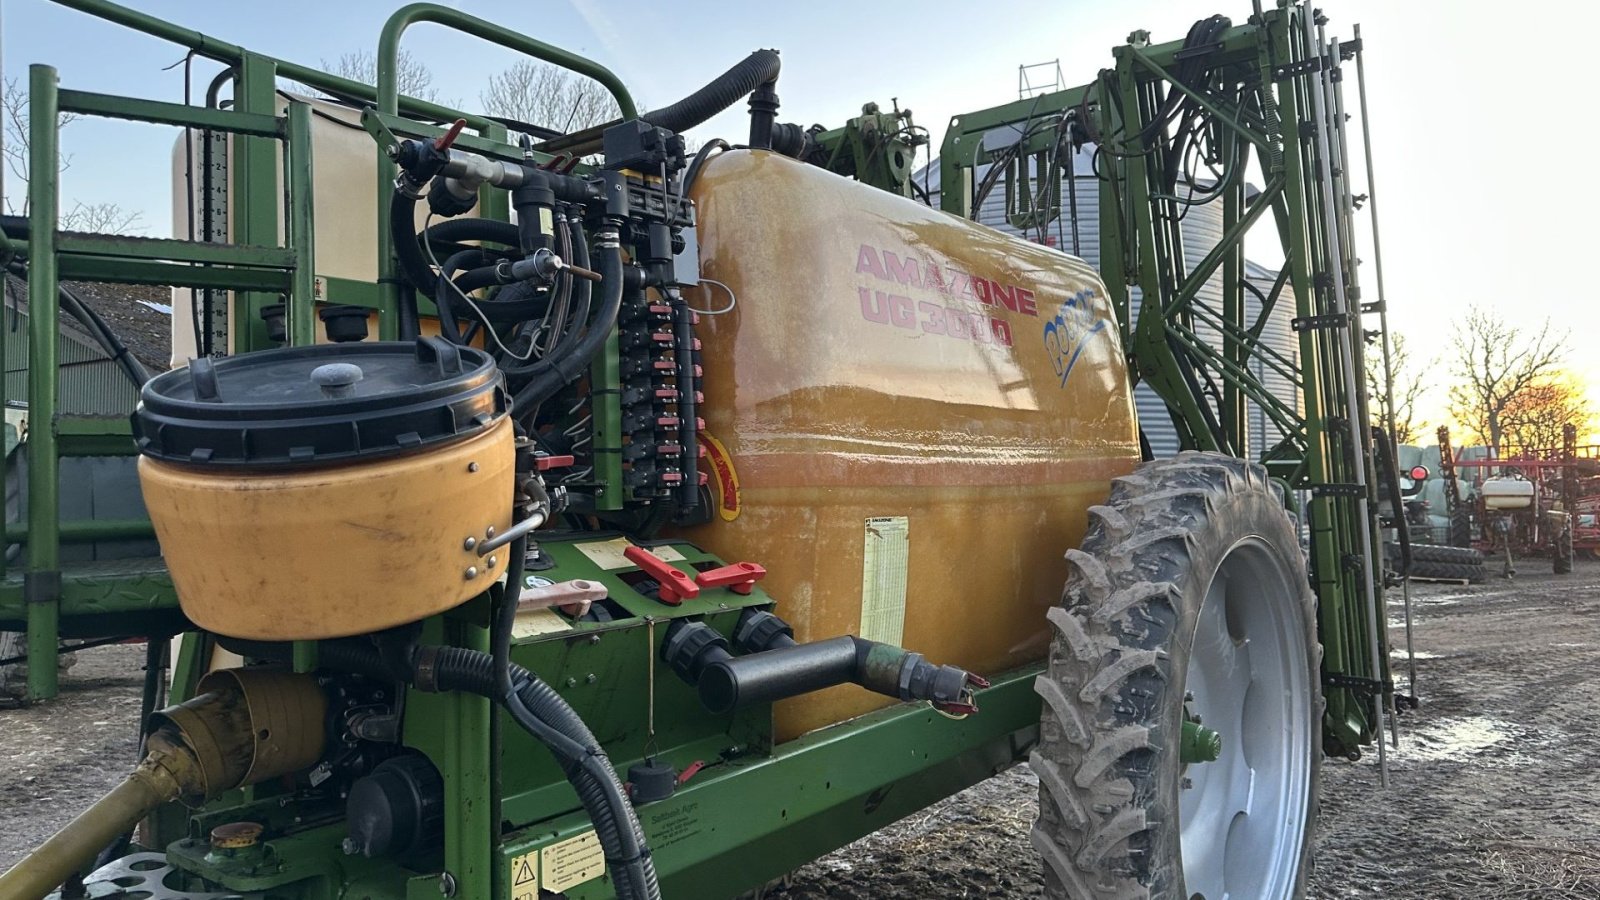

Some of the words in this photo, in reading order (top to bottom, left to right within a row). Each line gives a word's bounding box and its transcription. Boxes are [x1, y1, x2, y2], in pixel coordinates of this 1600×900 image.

[856, 244, 1039, 317] AMAZONE
[858, 287, 916, 330] UG
[919, 301, 1014, 349] 3000
